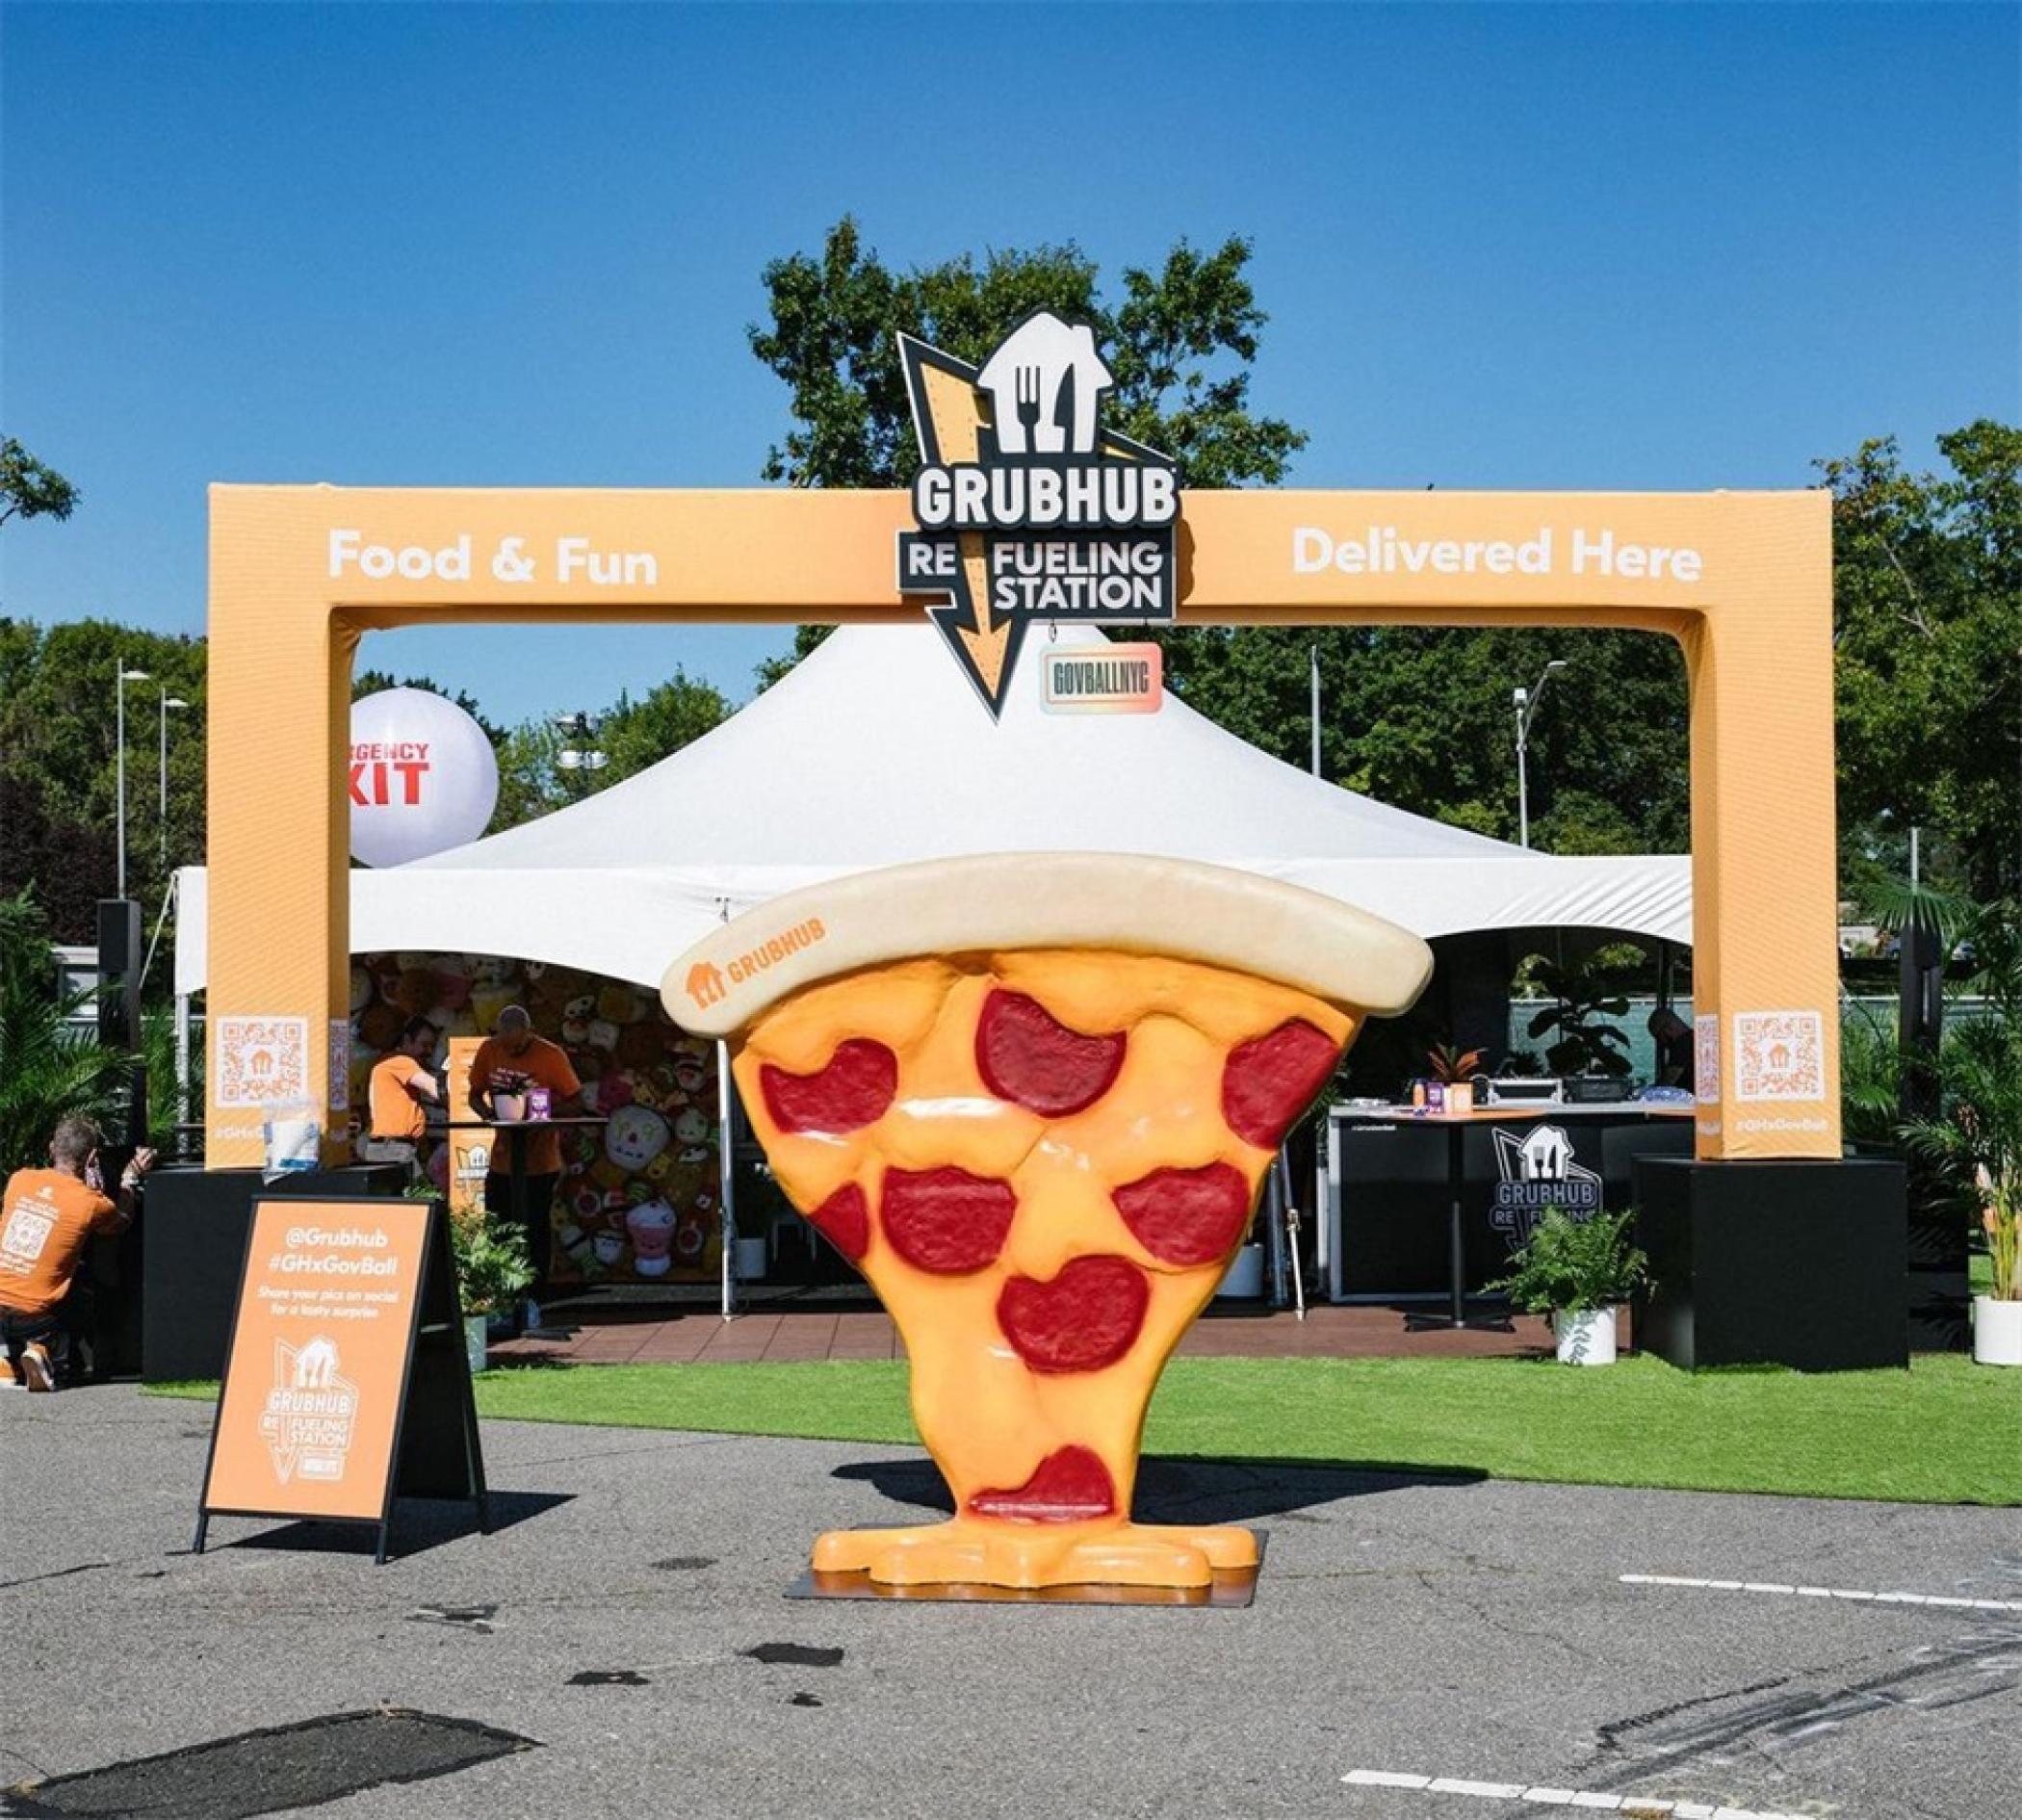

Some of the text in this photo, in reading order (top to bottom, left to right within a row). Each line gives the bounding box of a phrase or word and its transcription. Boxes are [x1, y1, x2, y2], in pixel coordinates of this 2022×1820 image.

[918, 467, 1177, 524] GRUBHUB
[329, 529, 658, 585] Food & Fun
[908, 540, 1163, 576] RE FUELING
[1292, 526, 1703, 583] Delivered Here
[993, 575, 1163, 609] STATION
[1053, 662, 1151, 694] GOVBALLNYC
[349, 742, 430, 761] GENCY
[727, 918, 827, 984] GRUBHUB
[1499, 1183, 1594, 1205] GRUBHUB
[1494, 1210, 1515, 1225] RE
[286, 1226, 389, 1249] @Grubhub
[269, 1254, 399, 1276] #GHxGovBall
[270, 1391, 350, 1414] GRUBHUB
[292, 1417, 348, 1431] FUELING
[291, 1431, 347, 1446] STATION
